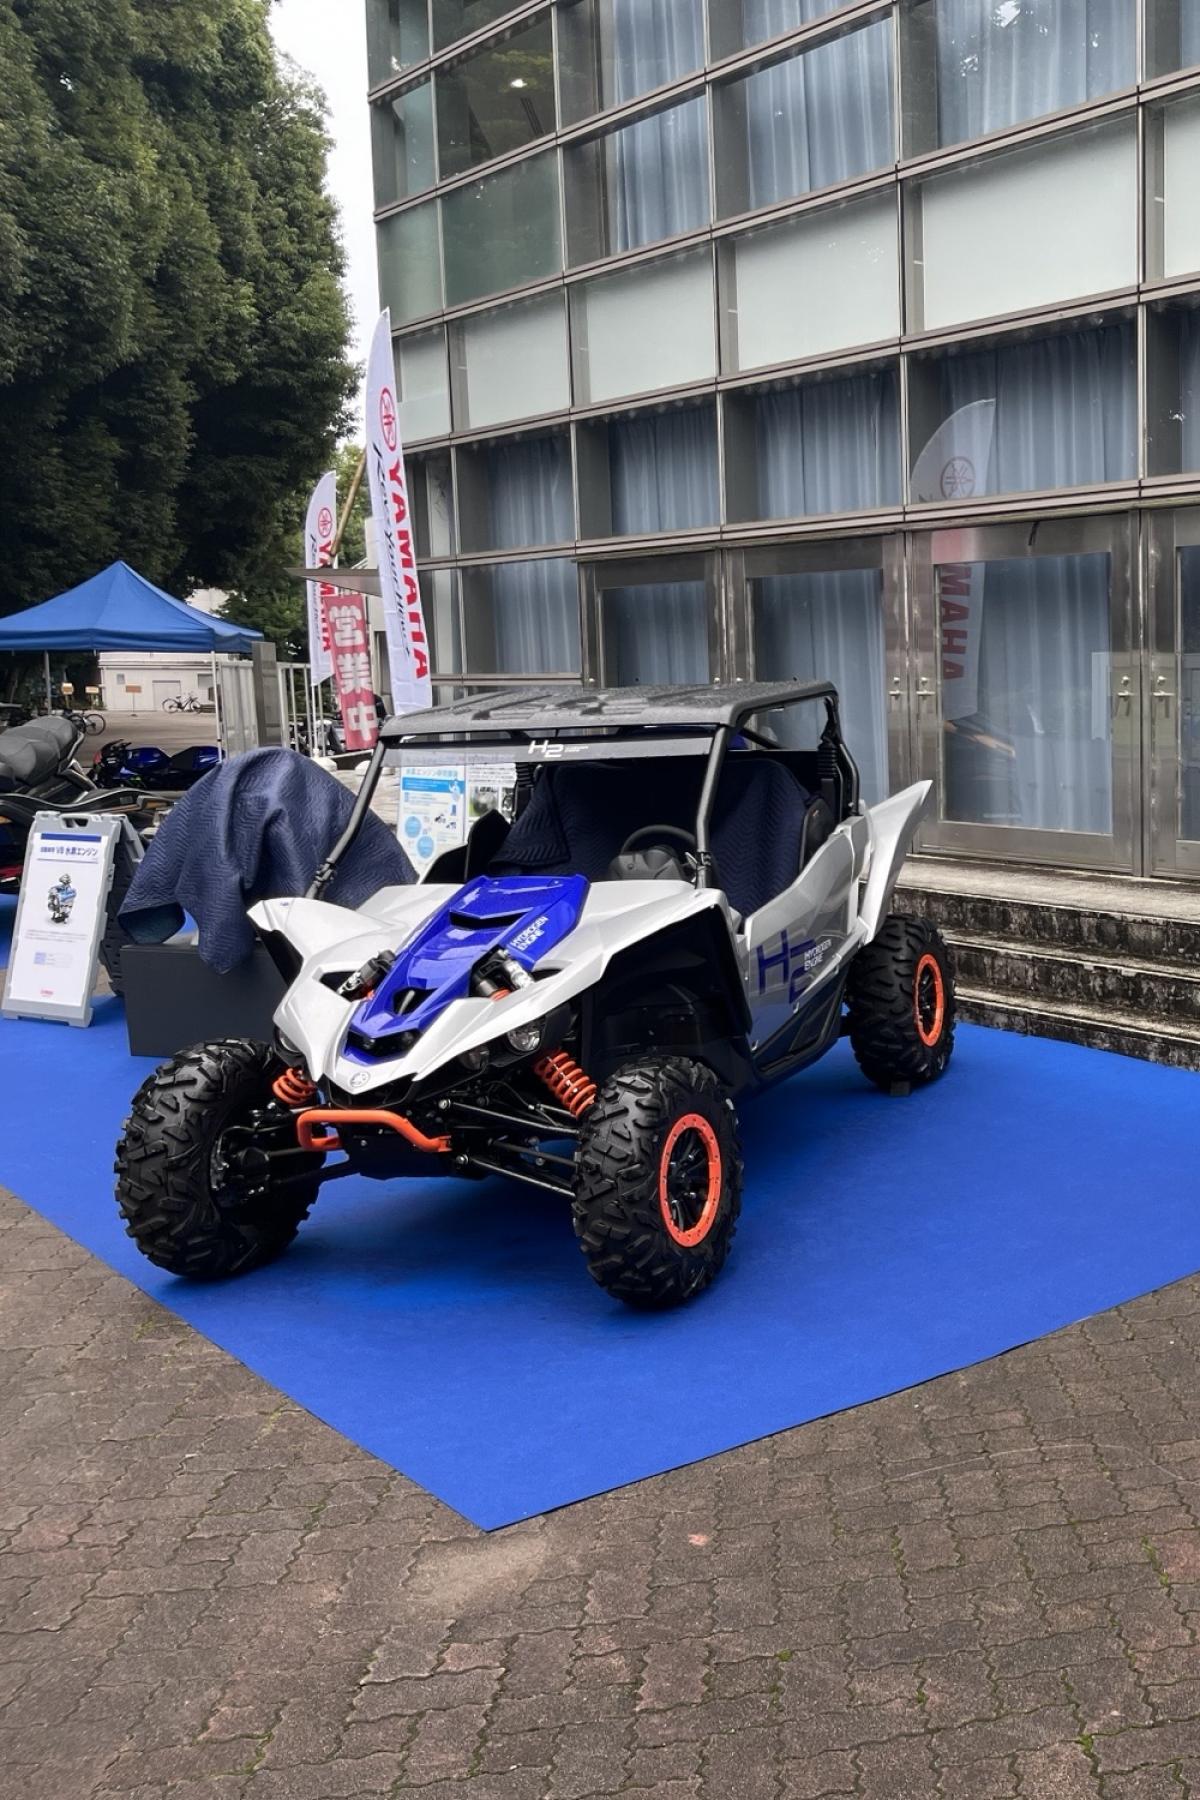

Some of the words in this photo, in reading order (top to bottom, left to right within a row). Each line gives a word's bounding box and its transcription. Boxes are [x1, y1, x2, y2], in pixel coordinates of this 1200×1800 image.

[389, 458, 428, 679] YAMAHA
[329, 605, 378, 741] 営業中
[528, 740, 564, 757] H2
[510, 916, 549, 947] HYDROGEN
